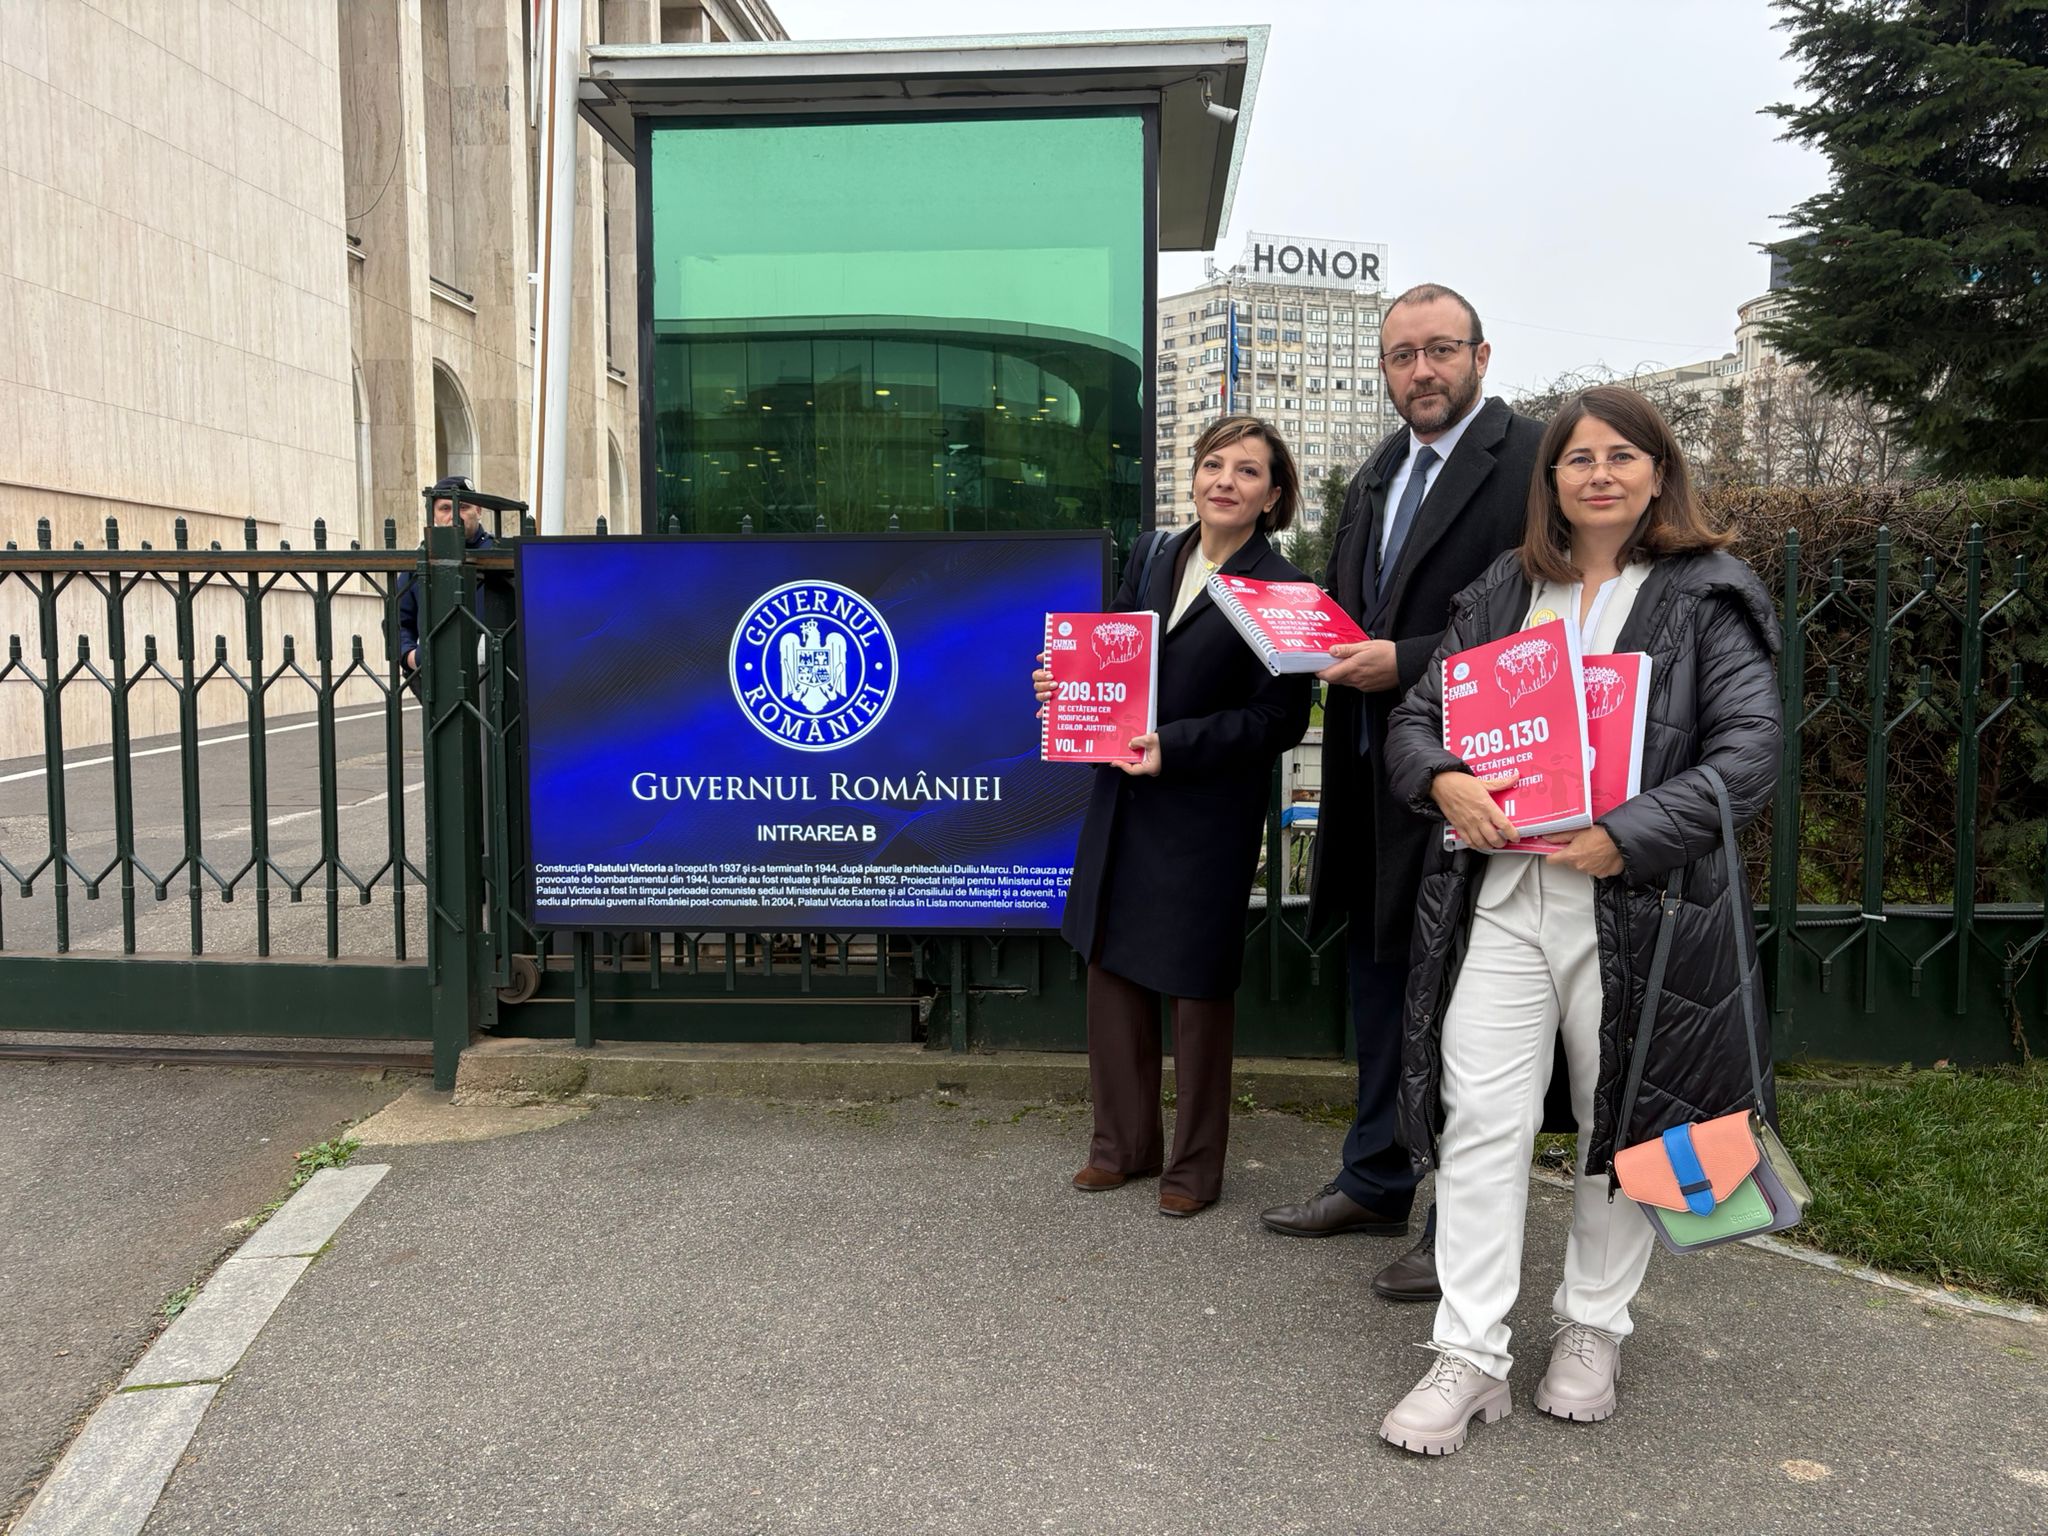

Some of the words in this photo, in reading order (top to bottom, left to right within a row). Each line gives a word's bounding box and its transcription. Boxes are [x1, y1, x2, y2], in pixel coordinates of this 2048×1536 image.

[1253, 243, 1380, 282] HONOR
[745, 590, 880, 648] GUVERNUL
[1257, 607, 1331, 622] 209.130
[1280, 638, 1314, 649] VOL.
[1314, 639, 1322, 649] I
[1058, 681, 1126, 702] 209.130
[1449, 680, 1478, 695] FUNKY
[744, 684, 886, 742] ROMÂNIEI
[1058, 704, 1066, 712] DE
[1057, 714, 1099, 722] MODIFICAREA
[1057, 723, 1083, 731] LEGILOR
[1055, 738, 1082, 752] VOL.
[1085, 739, 1094, 753] II
[1460, 716, 1549, 761] 209.130
[1476, 756, 1515, 772] CETĂȚENI
[1516, 752, 1533, 763] CER
[631, 772, 817, 801] GUVERNUL
[829, 770, 1002, 801] ROMÂNIEI
[757, 825, 857, 842] INTRAREA
[863, 825, 876, 842] B
[588, 864, 628, 872] Palatului
[630, 864, 666, 873] Victoria
[720, 864, 740, 873] 1937
[767, 865, 803, 873] terminat
[865, 865, 902, 876] planurile
[904, 865, 952, 874] arhitectului
[954, 865, 978, 874] Duiliu
[981, 866, 1011, 874] Marcu.
[1014, 866, 1028, 874] Din
[536, 875, 579, 886] provocate
[582, 875, 592, 883] de
[594, 875, 668, 884] bombardamentul
[670, 875, 683, 884] din
[762, 876, 778, 884] fost
[780, 876, 810, 884] reluate
[822, 876, 861, 884] finalizate
[874, 876, 898, 885] 1952.
[901, 876, 940, 885] Proiectat
[967, 877, 996, 888] pentru
[998, 877, 1041, 885] Ministerul
[1043, 877, 1054, 885] de
[536, 886, 566, 894] Palatul
[568, 886, 601, 894] Victoria
[611, 886, 627, 895] fost
[640, 886, 666, 897] timpul
[668, 886, 708, 897] perioadei
[711, 887, 756, 895] comuniste
[758, 887, 784, 895] sediul
[786, 887, 836, 895] Ministerului
[838, 887, 849, 896] de
[898, 887, 905, 896] al
[908, 888, 953, 896] Consiliului
[955, 888, 966, 896] de
[1020, 888, 1056, 898] devenit,
[536, 897, 560, 905] sediu
[562, 897, 569, 906] al
[571, 897, 605, 908] primului
[606, 899, 636, 908] guvern
[638, 897, 646, 906] al
[690, 898, 760, 909] post-comuniste.
[798, 898, 828, 907] Palatul
[830, 898, 862, 907] Victoria
[872, 898, 887, 907] fost
[889, 899, 914, 907] inclus
[926, 899, 947, 907] Lista
[949, 899, 1013, 907] monumentelor
[1015, 899, 1050, 908] istorice.
